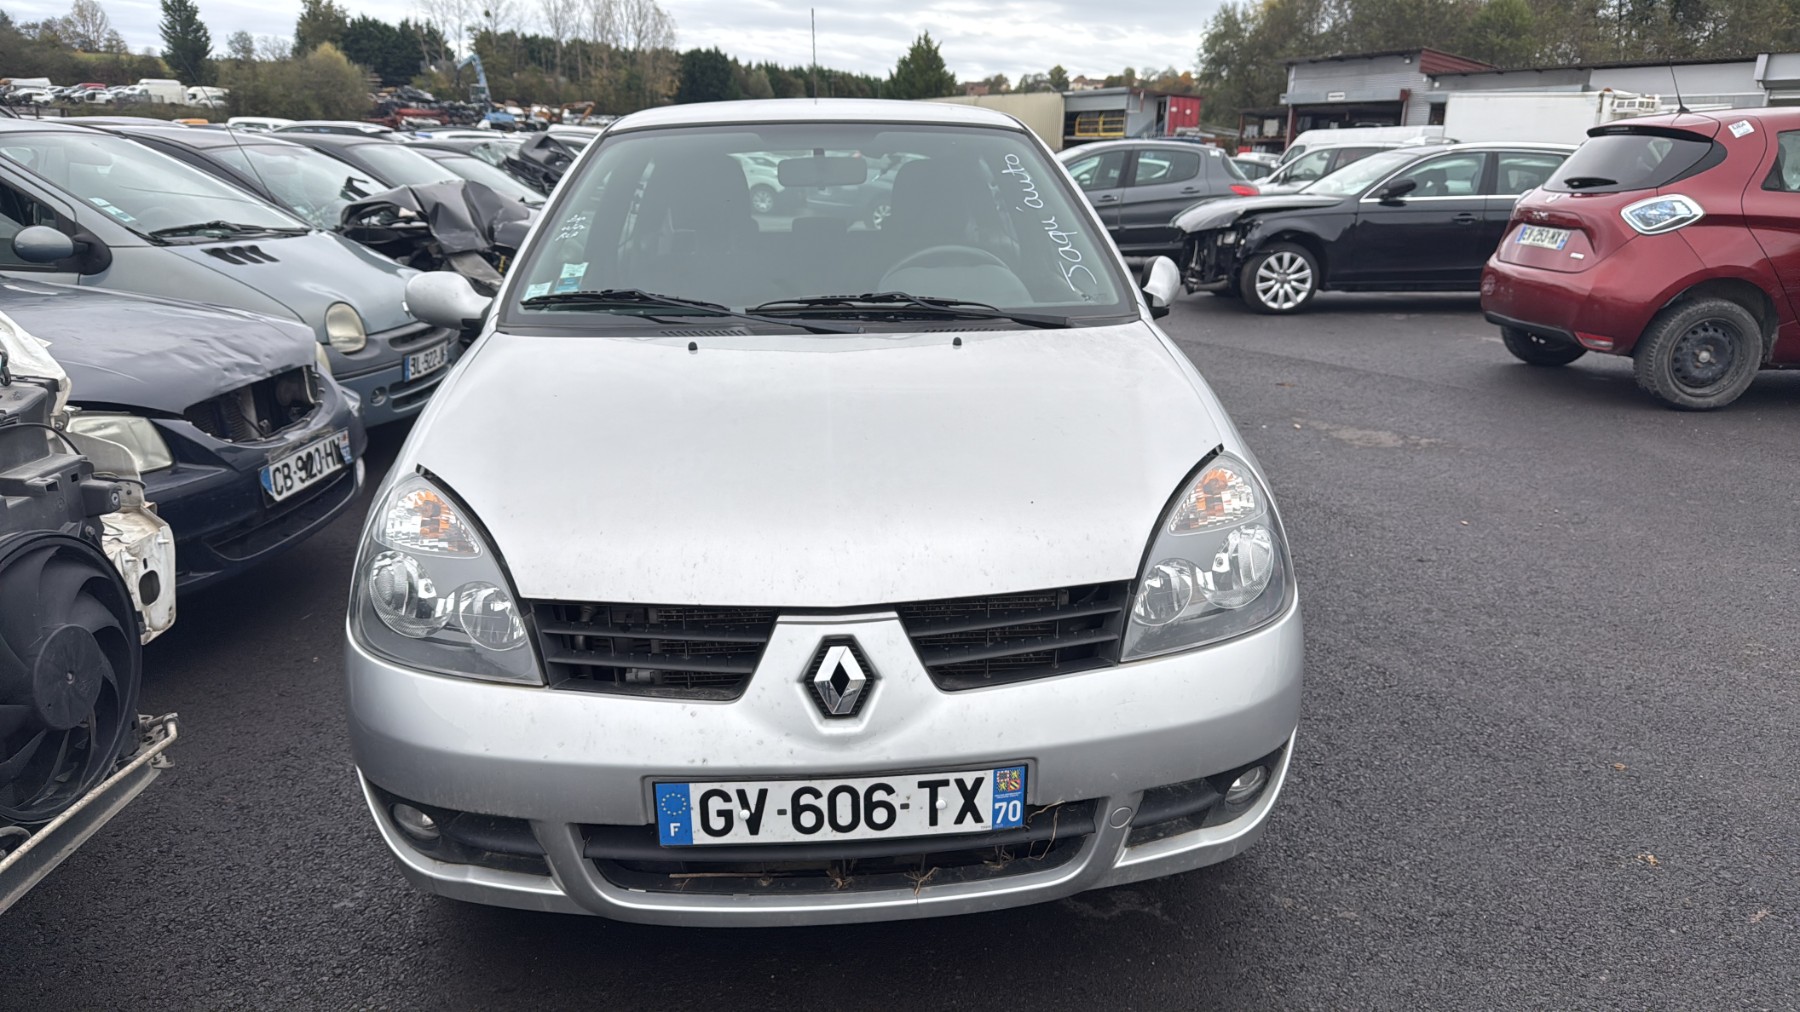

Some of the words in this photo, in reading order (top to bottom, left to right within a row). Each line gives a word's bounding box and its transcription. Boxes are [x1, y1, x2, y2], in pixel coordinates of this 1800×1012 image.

[699, 776, 985, 838] GV-606-TX
[994, 799, 1022, 824] 70
[669, 822, 681, 837] F
